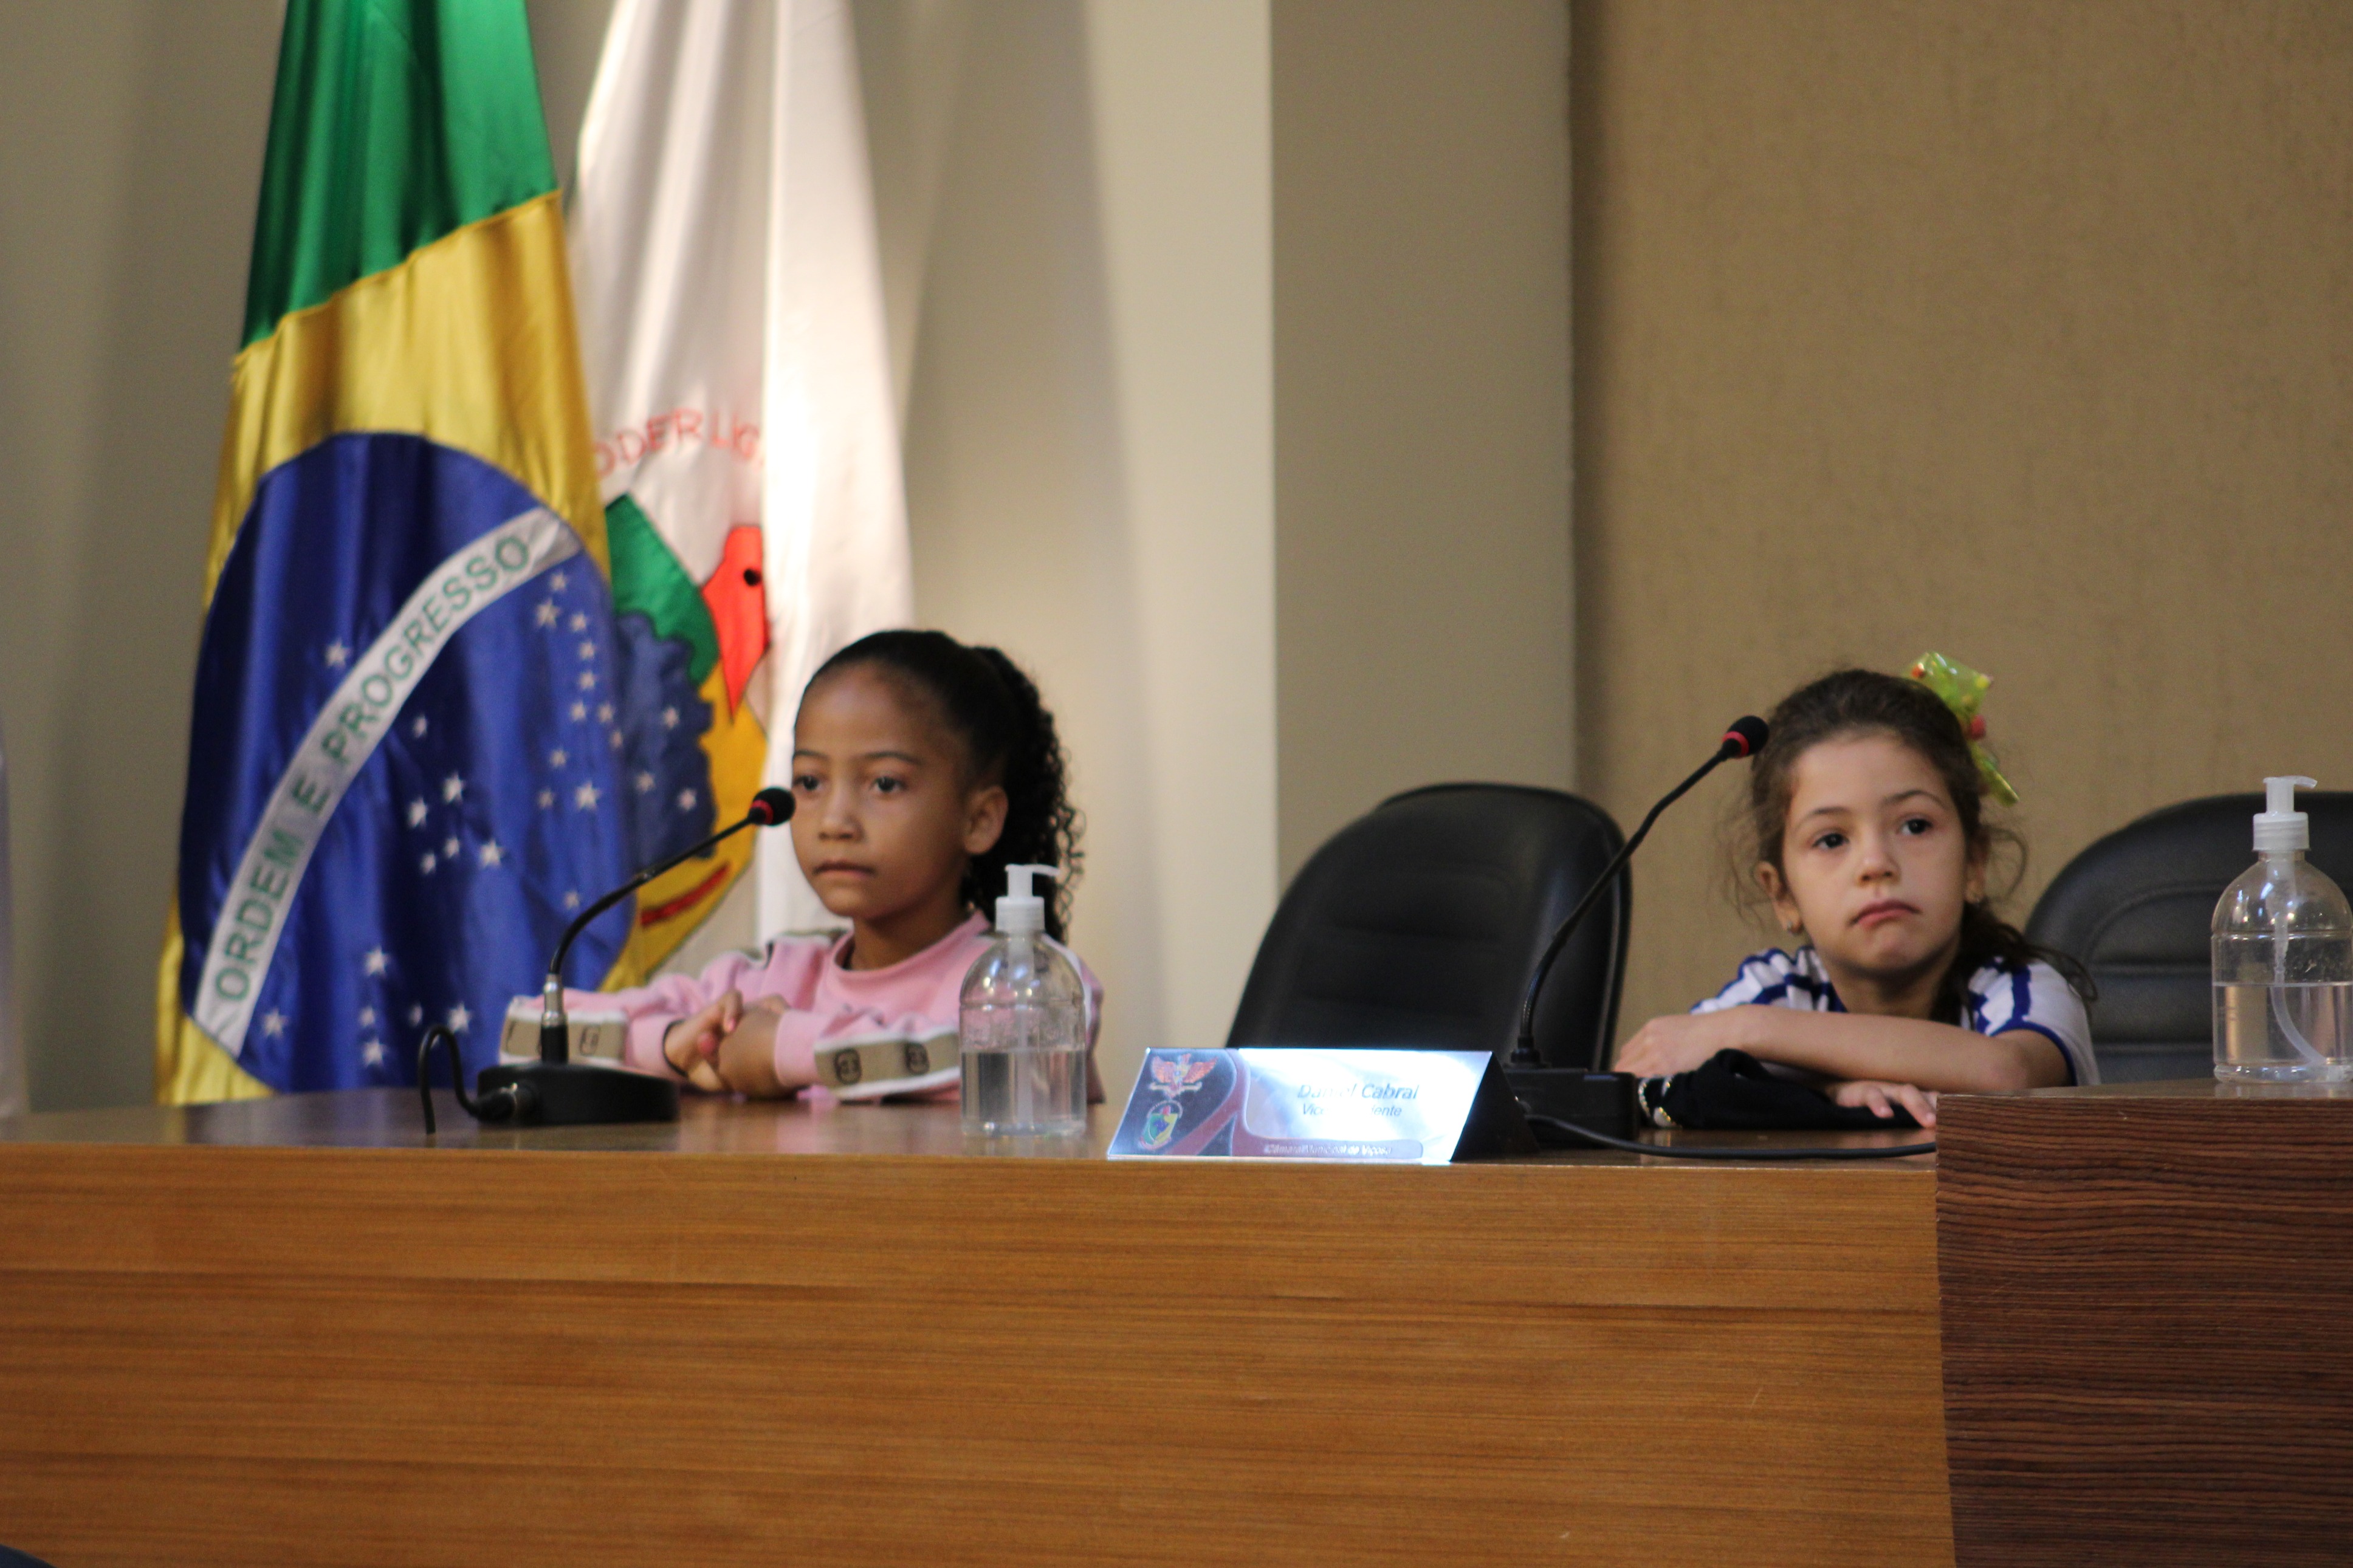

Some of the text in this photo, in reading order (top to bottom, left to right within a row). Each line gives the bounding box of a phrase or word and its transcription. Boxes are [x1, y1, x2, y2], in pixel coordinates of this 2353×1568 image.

[215, 535, 530, 1001] ORDEM E PROGRESSO
[1361, 1083, 1420, 1099] Cabral
